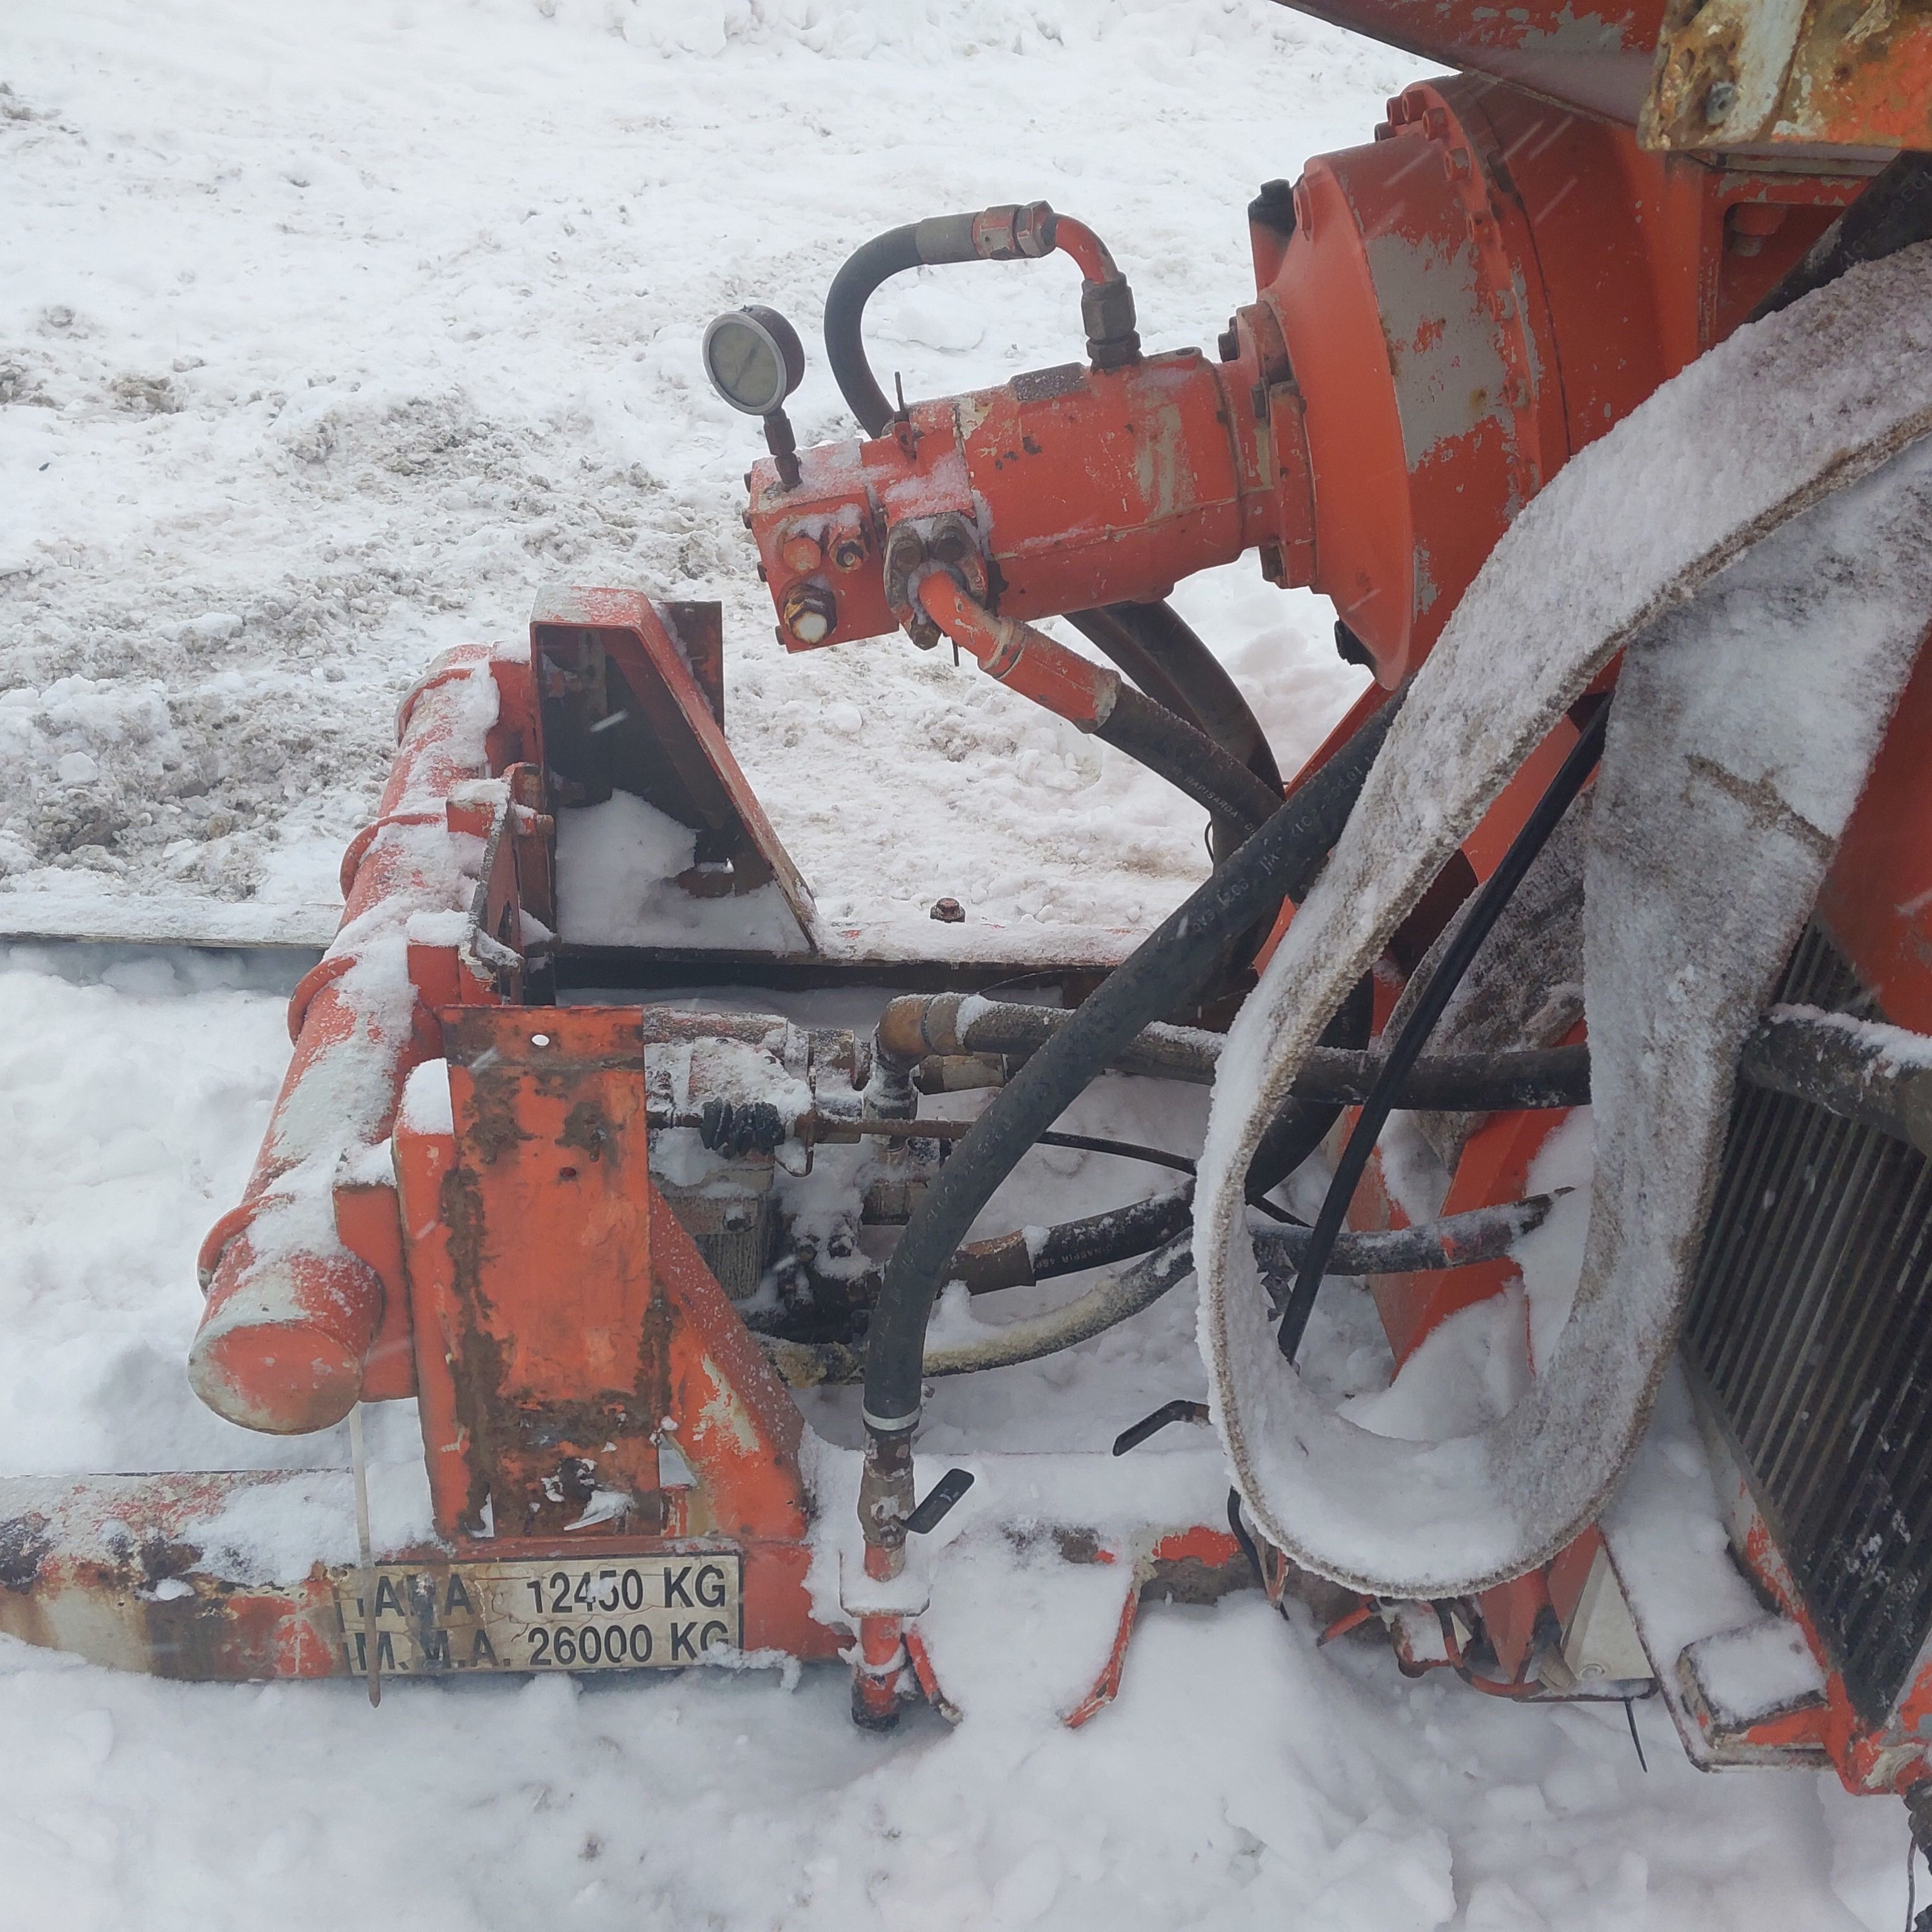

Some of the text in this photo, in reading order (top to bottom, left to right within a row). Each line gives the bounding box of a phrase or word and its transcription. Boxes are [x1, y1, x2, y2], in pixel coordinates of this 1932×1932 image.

[526, 1568, 644, 1613] 12450
[663, 1563, 726, 1609] KG
[527, 1623, 653, 1666] 26000
